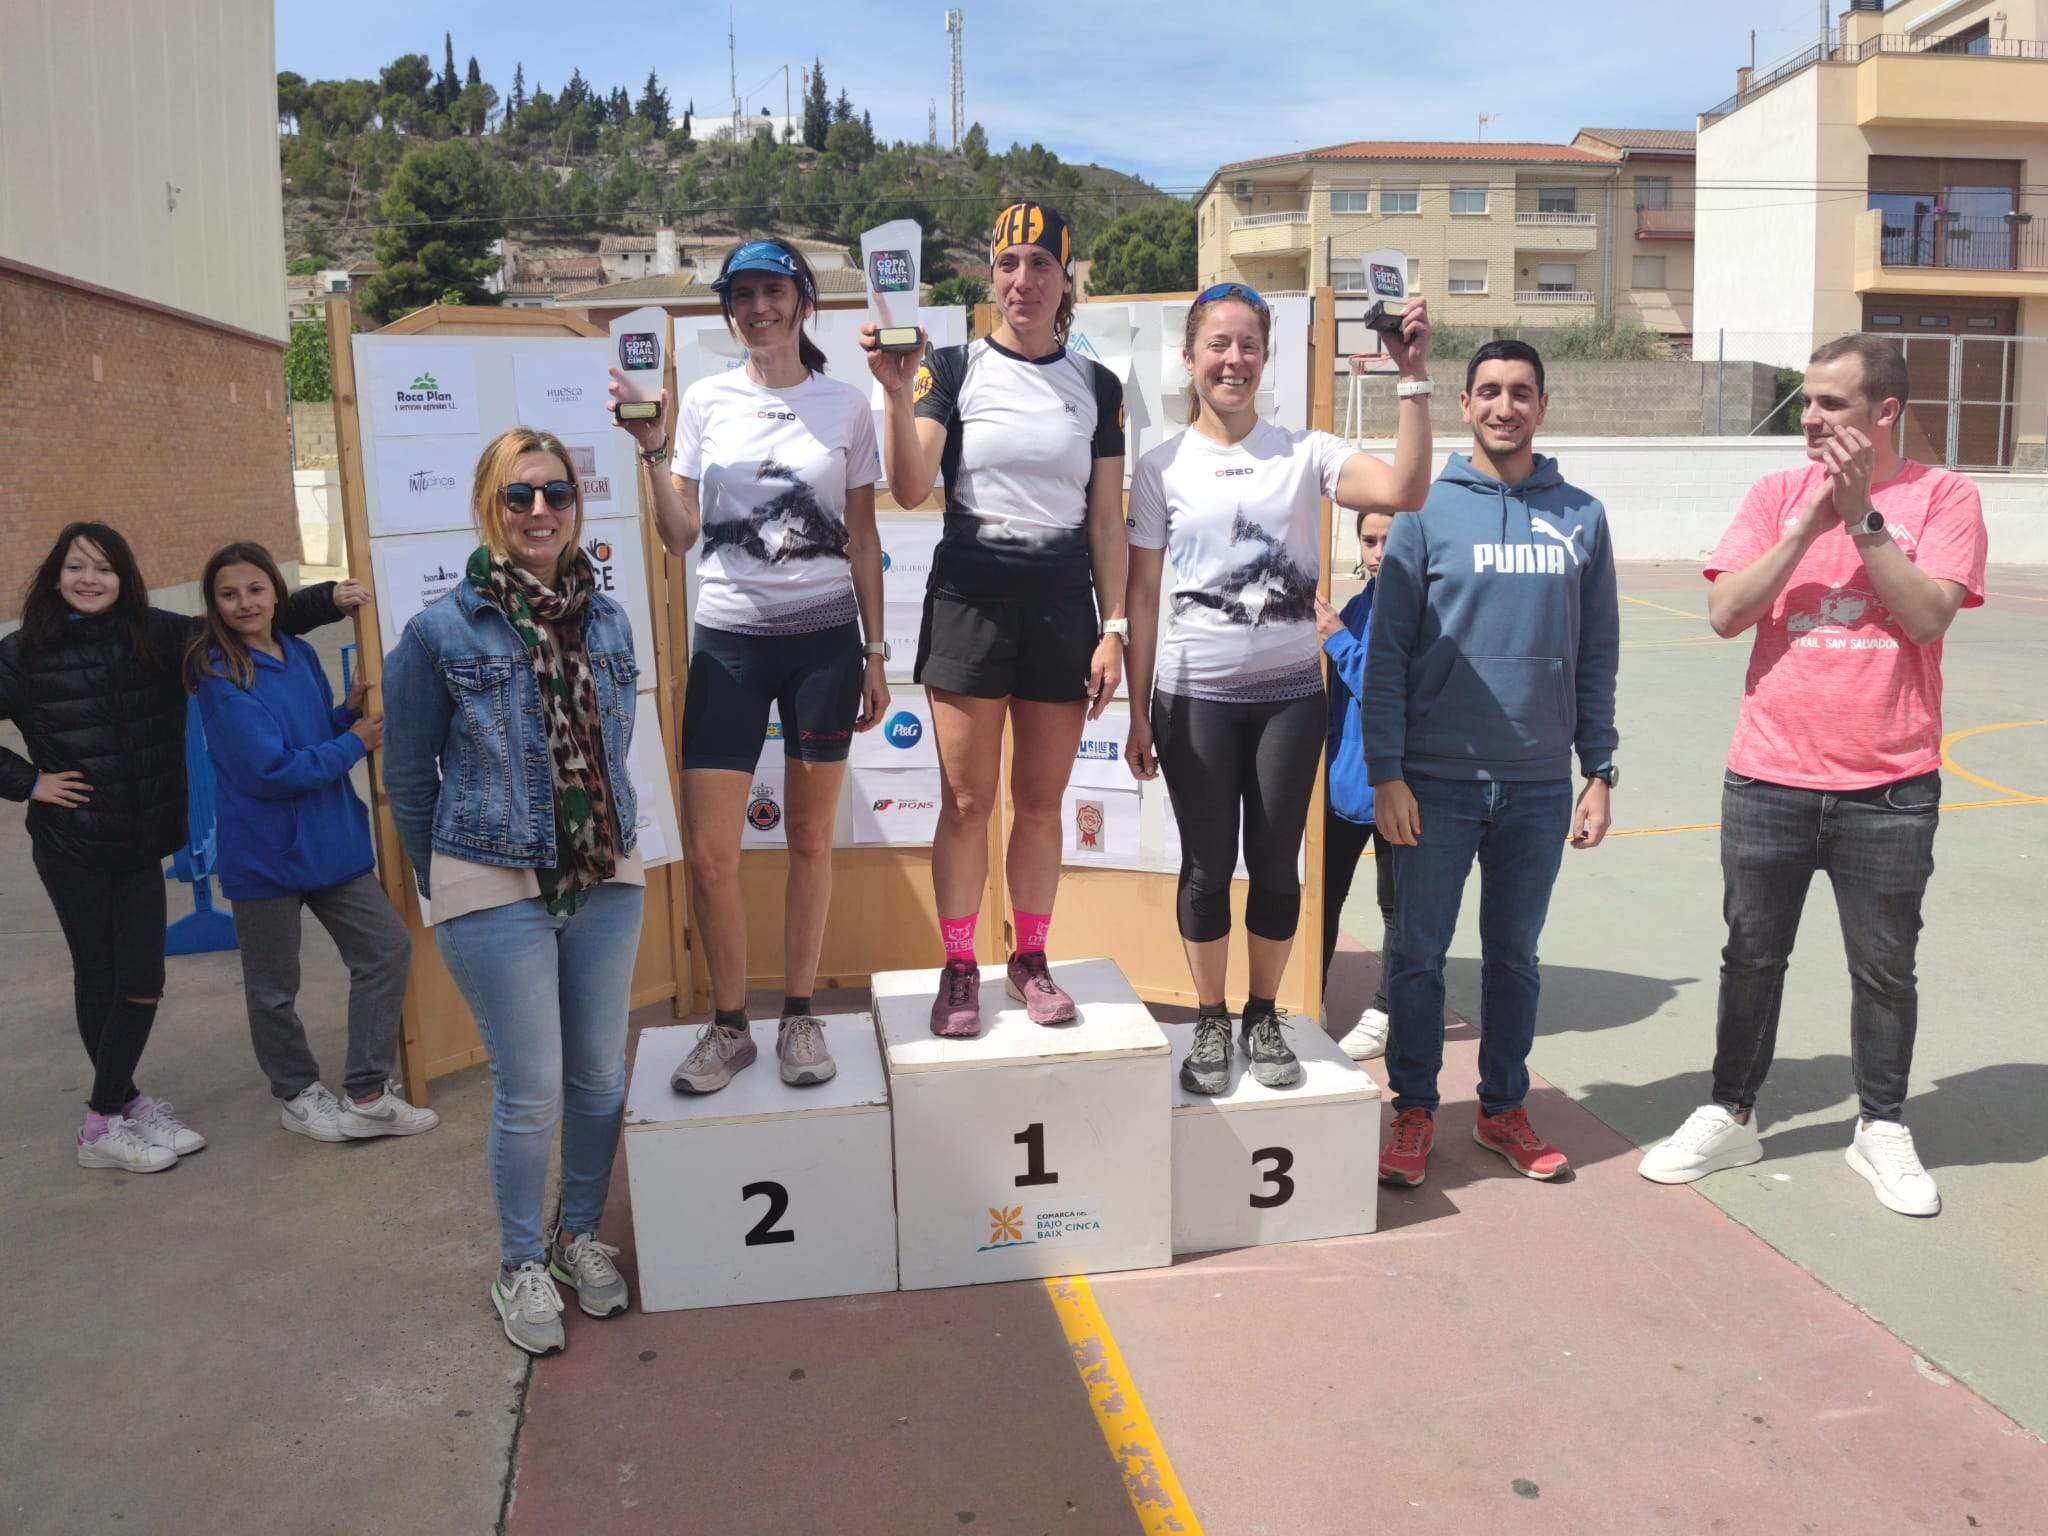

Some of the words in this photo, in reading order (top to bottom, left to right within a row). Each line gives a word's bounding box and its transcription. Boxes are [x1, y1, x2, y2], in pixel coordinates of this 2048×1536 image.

[877, 259, 906, 267] COPA
[878, 266, 907, 275] TRAIL
[1376, 271, 1397, 280] COPA
[880, 277, 908, 285] CINCA
[626, 341, 652, 349] COPA
[397, 391, 424, 402] Roca
[427, 390, 452, 401] Plan
[1473, 543, 1565, 575] PUMA
[1795, 637, 1821, 648] TRAIL
[1825, 638, 1846, 648] SAN
[1850, 639, 1899, 650] SALVADOR
[892, 723, 919, 737] P&G
[1014, 1122, 1058, 1187] 1
[1249, 1146, 1295, 1209] 3
[742, 1181, 795, 1247] 2
[1037, 1211, 1075, 1220] COMARCA
[1037, 1220, 1063, 1230] BAJO
[1065, 1221, 1101, 1232] CINCA
[1037, 1230, 1063, 1239] BAIX
